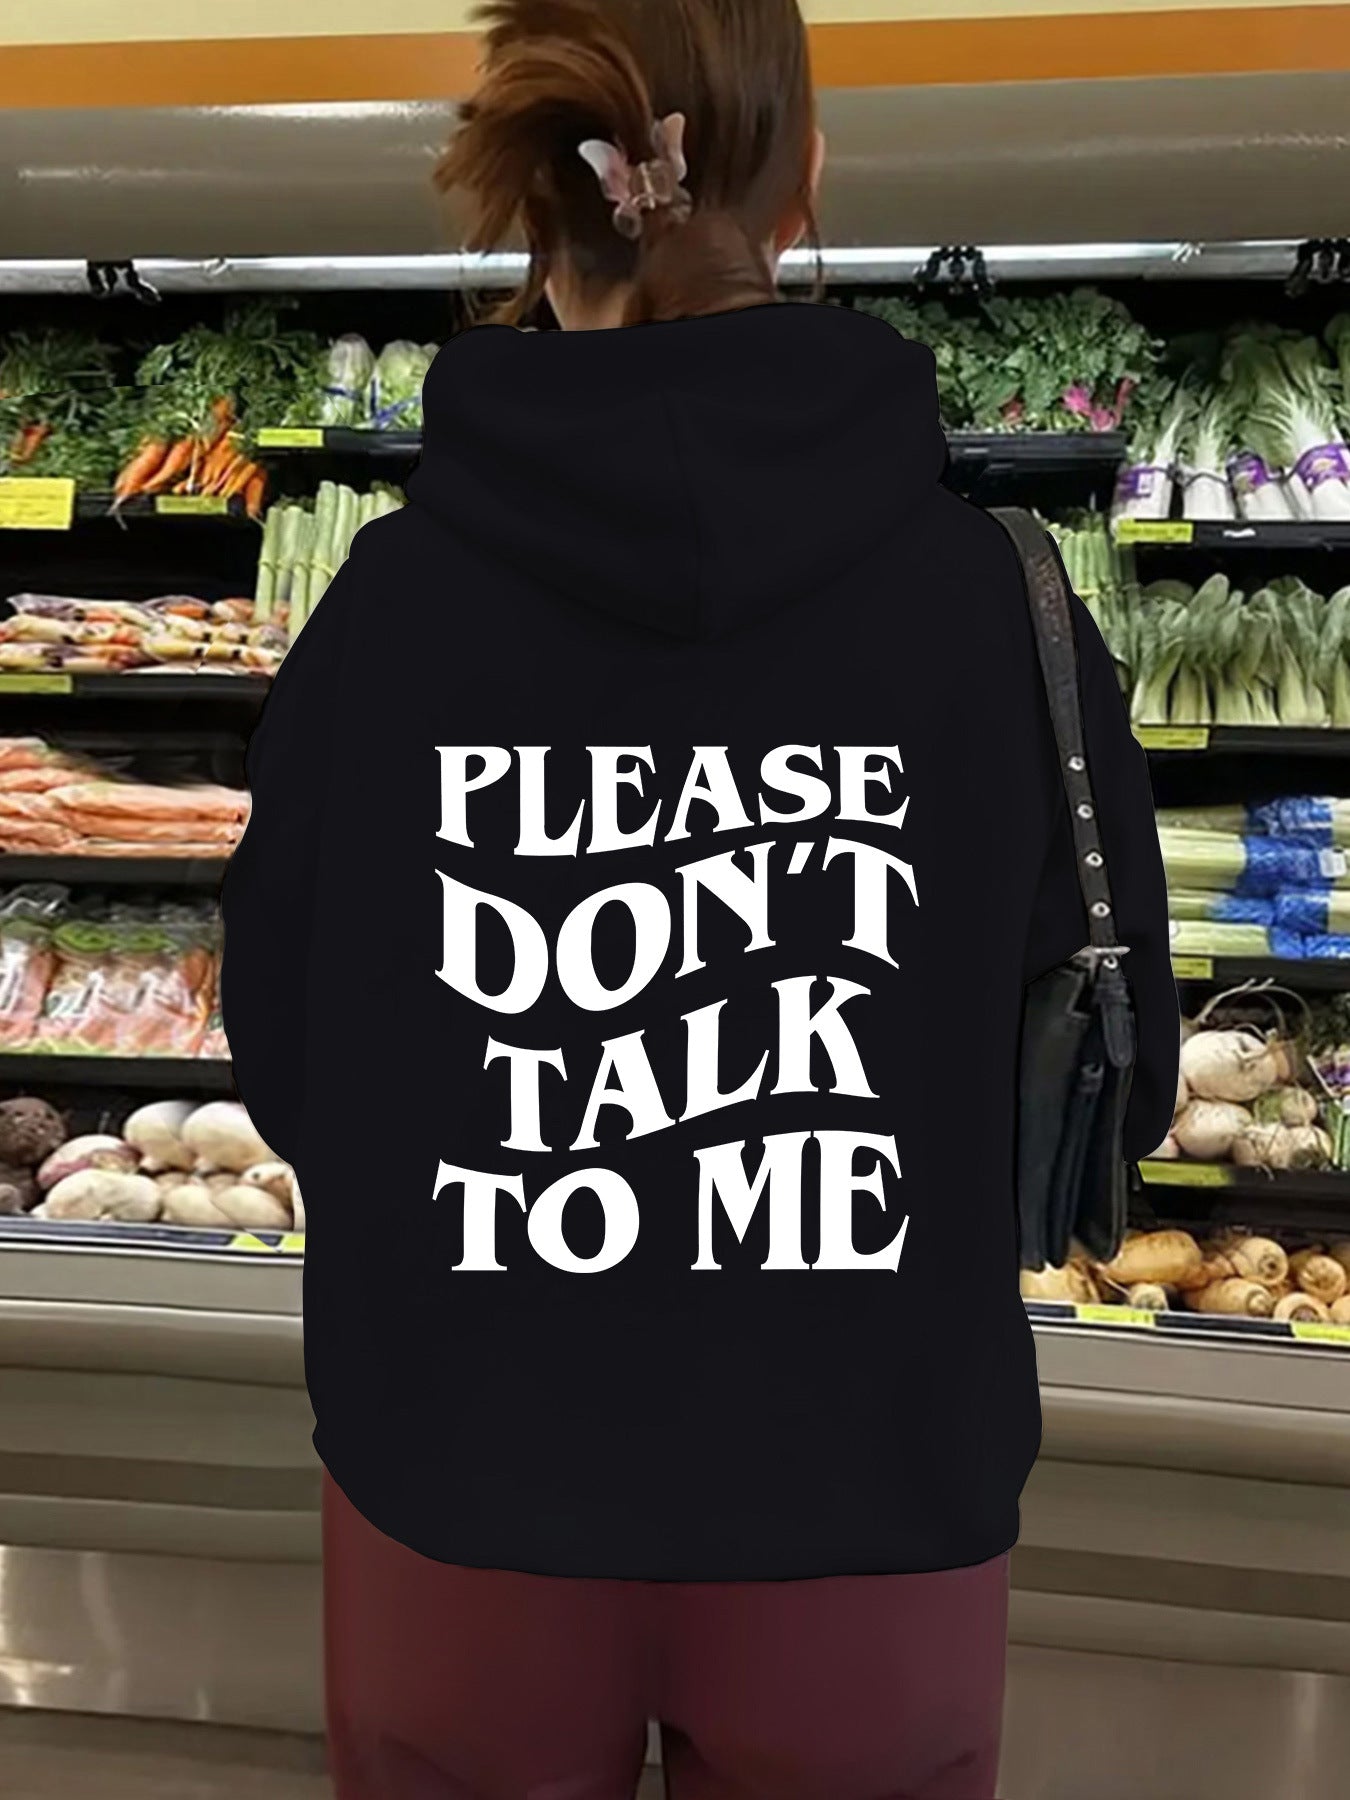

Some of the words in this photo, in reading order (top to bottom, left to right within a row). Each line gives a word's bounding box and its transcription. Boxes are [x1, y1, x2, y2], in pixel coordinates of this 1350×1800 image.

[434, 744, 911, 858] PLEASE
[434, 835, 920, 1015] DON'T
[483, 975, 881, 1152] TALK
[432, 1158, 640, 1274] TO
[690, 1130, 910, 1273] ME
